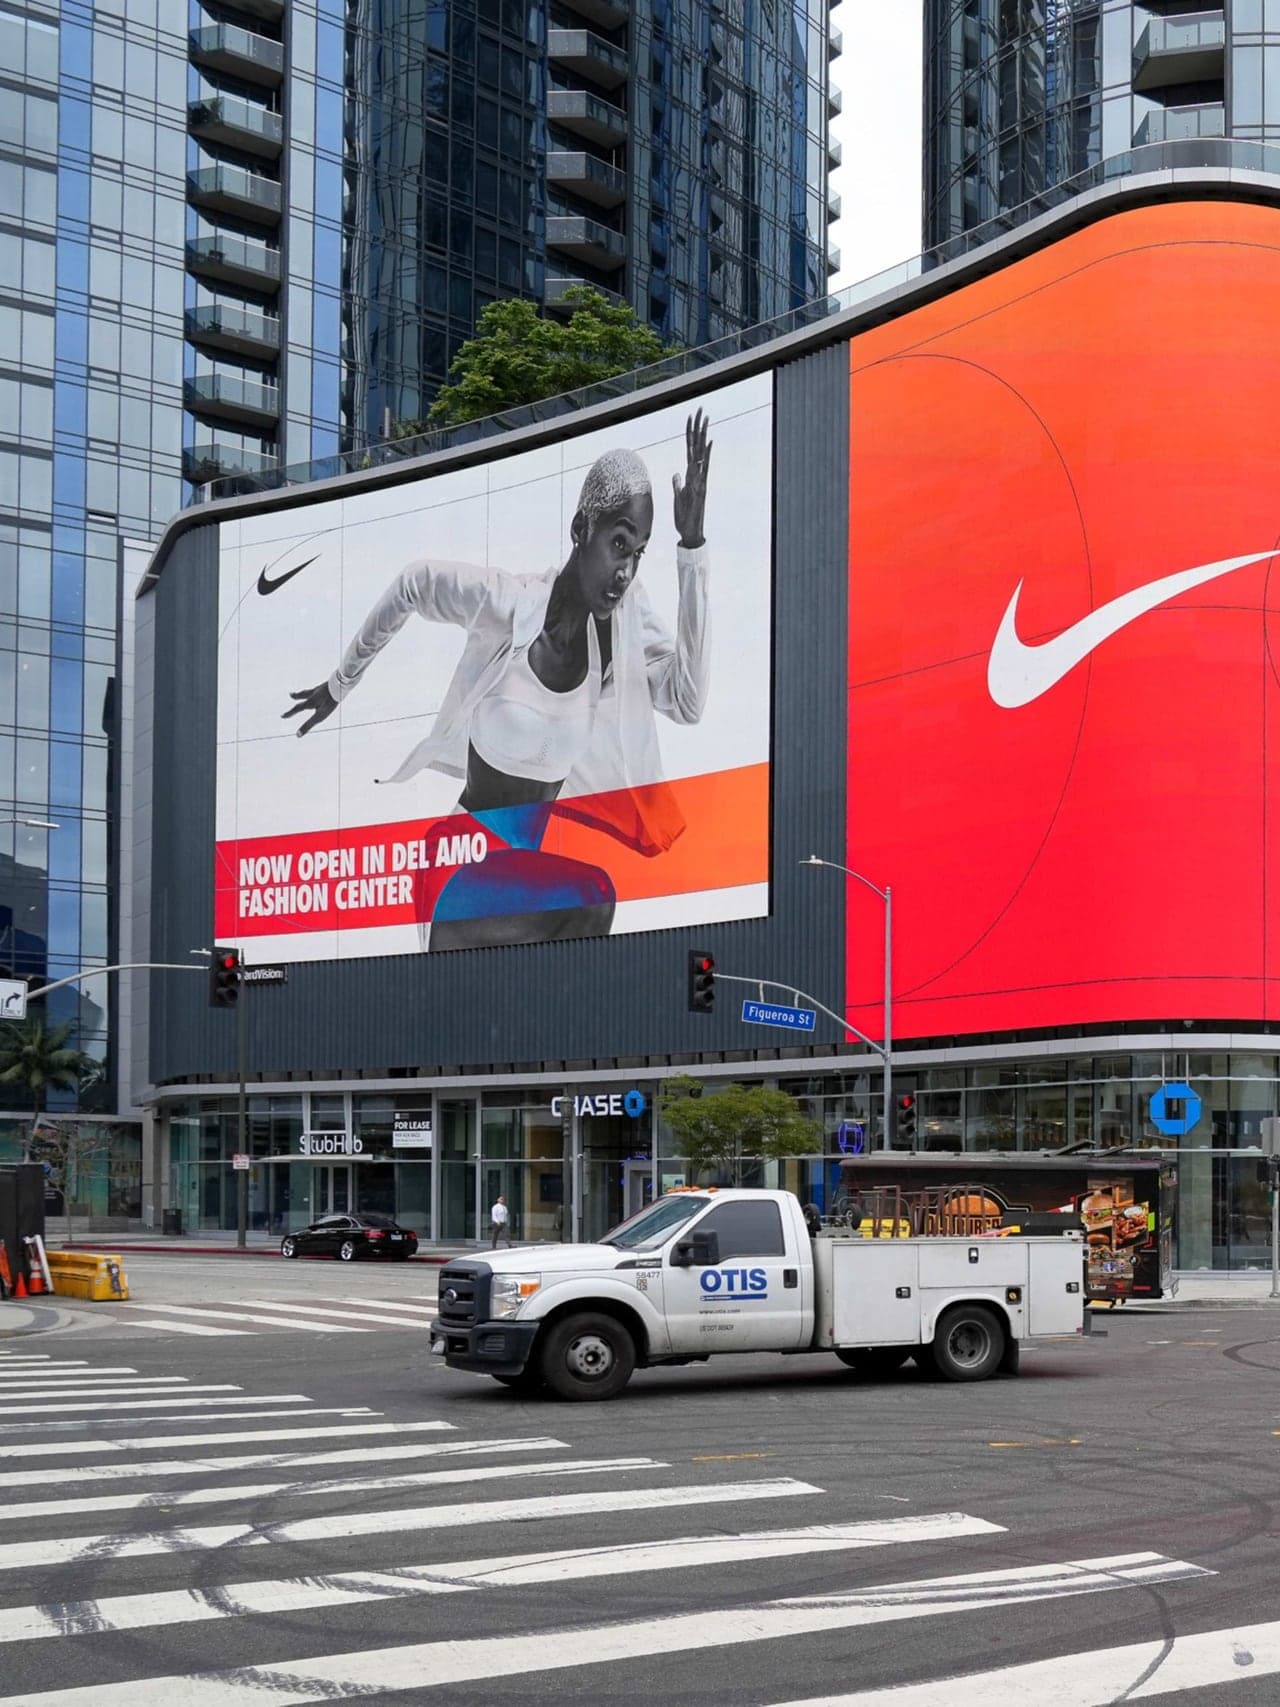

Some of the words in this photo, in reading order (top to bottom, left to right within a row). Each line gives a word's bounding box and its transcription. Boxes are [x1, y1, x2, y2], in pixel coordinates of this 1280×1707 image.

[239, 854, 293, 886] NOW
[297, 847, 355, 881] OPEN
[362, 845, 385, 875] IN
[392, 839, 430, 872] DEL
[435, 832, 488, 867] AMO
[239, 882, 328, 918] FASHION
[335, 875, 413, 910] CENTER
[749, 1006, 795, 1023] Figueroa
[798, 1013, 810, 1025] St
[394, 1121, 408, 1130] FOR
[409, 1120, 430, 1130] LEASE
[299, 1133, 363, 1153] StubHb
[700, 1268, 768, 1292] OTIS
